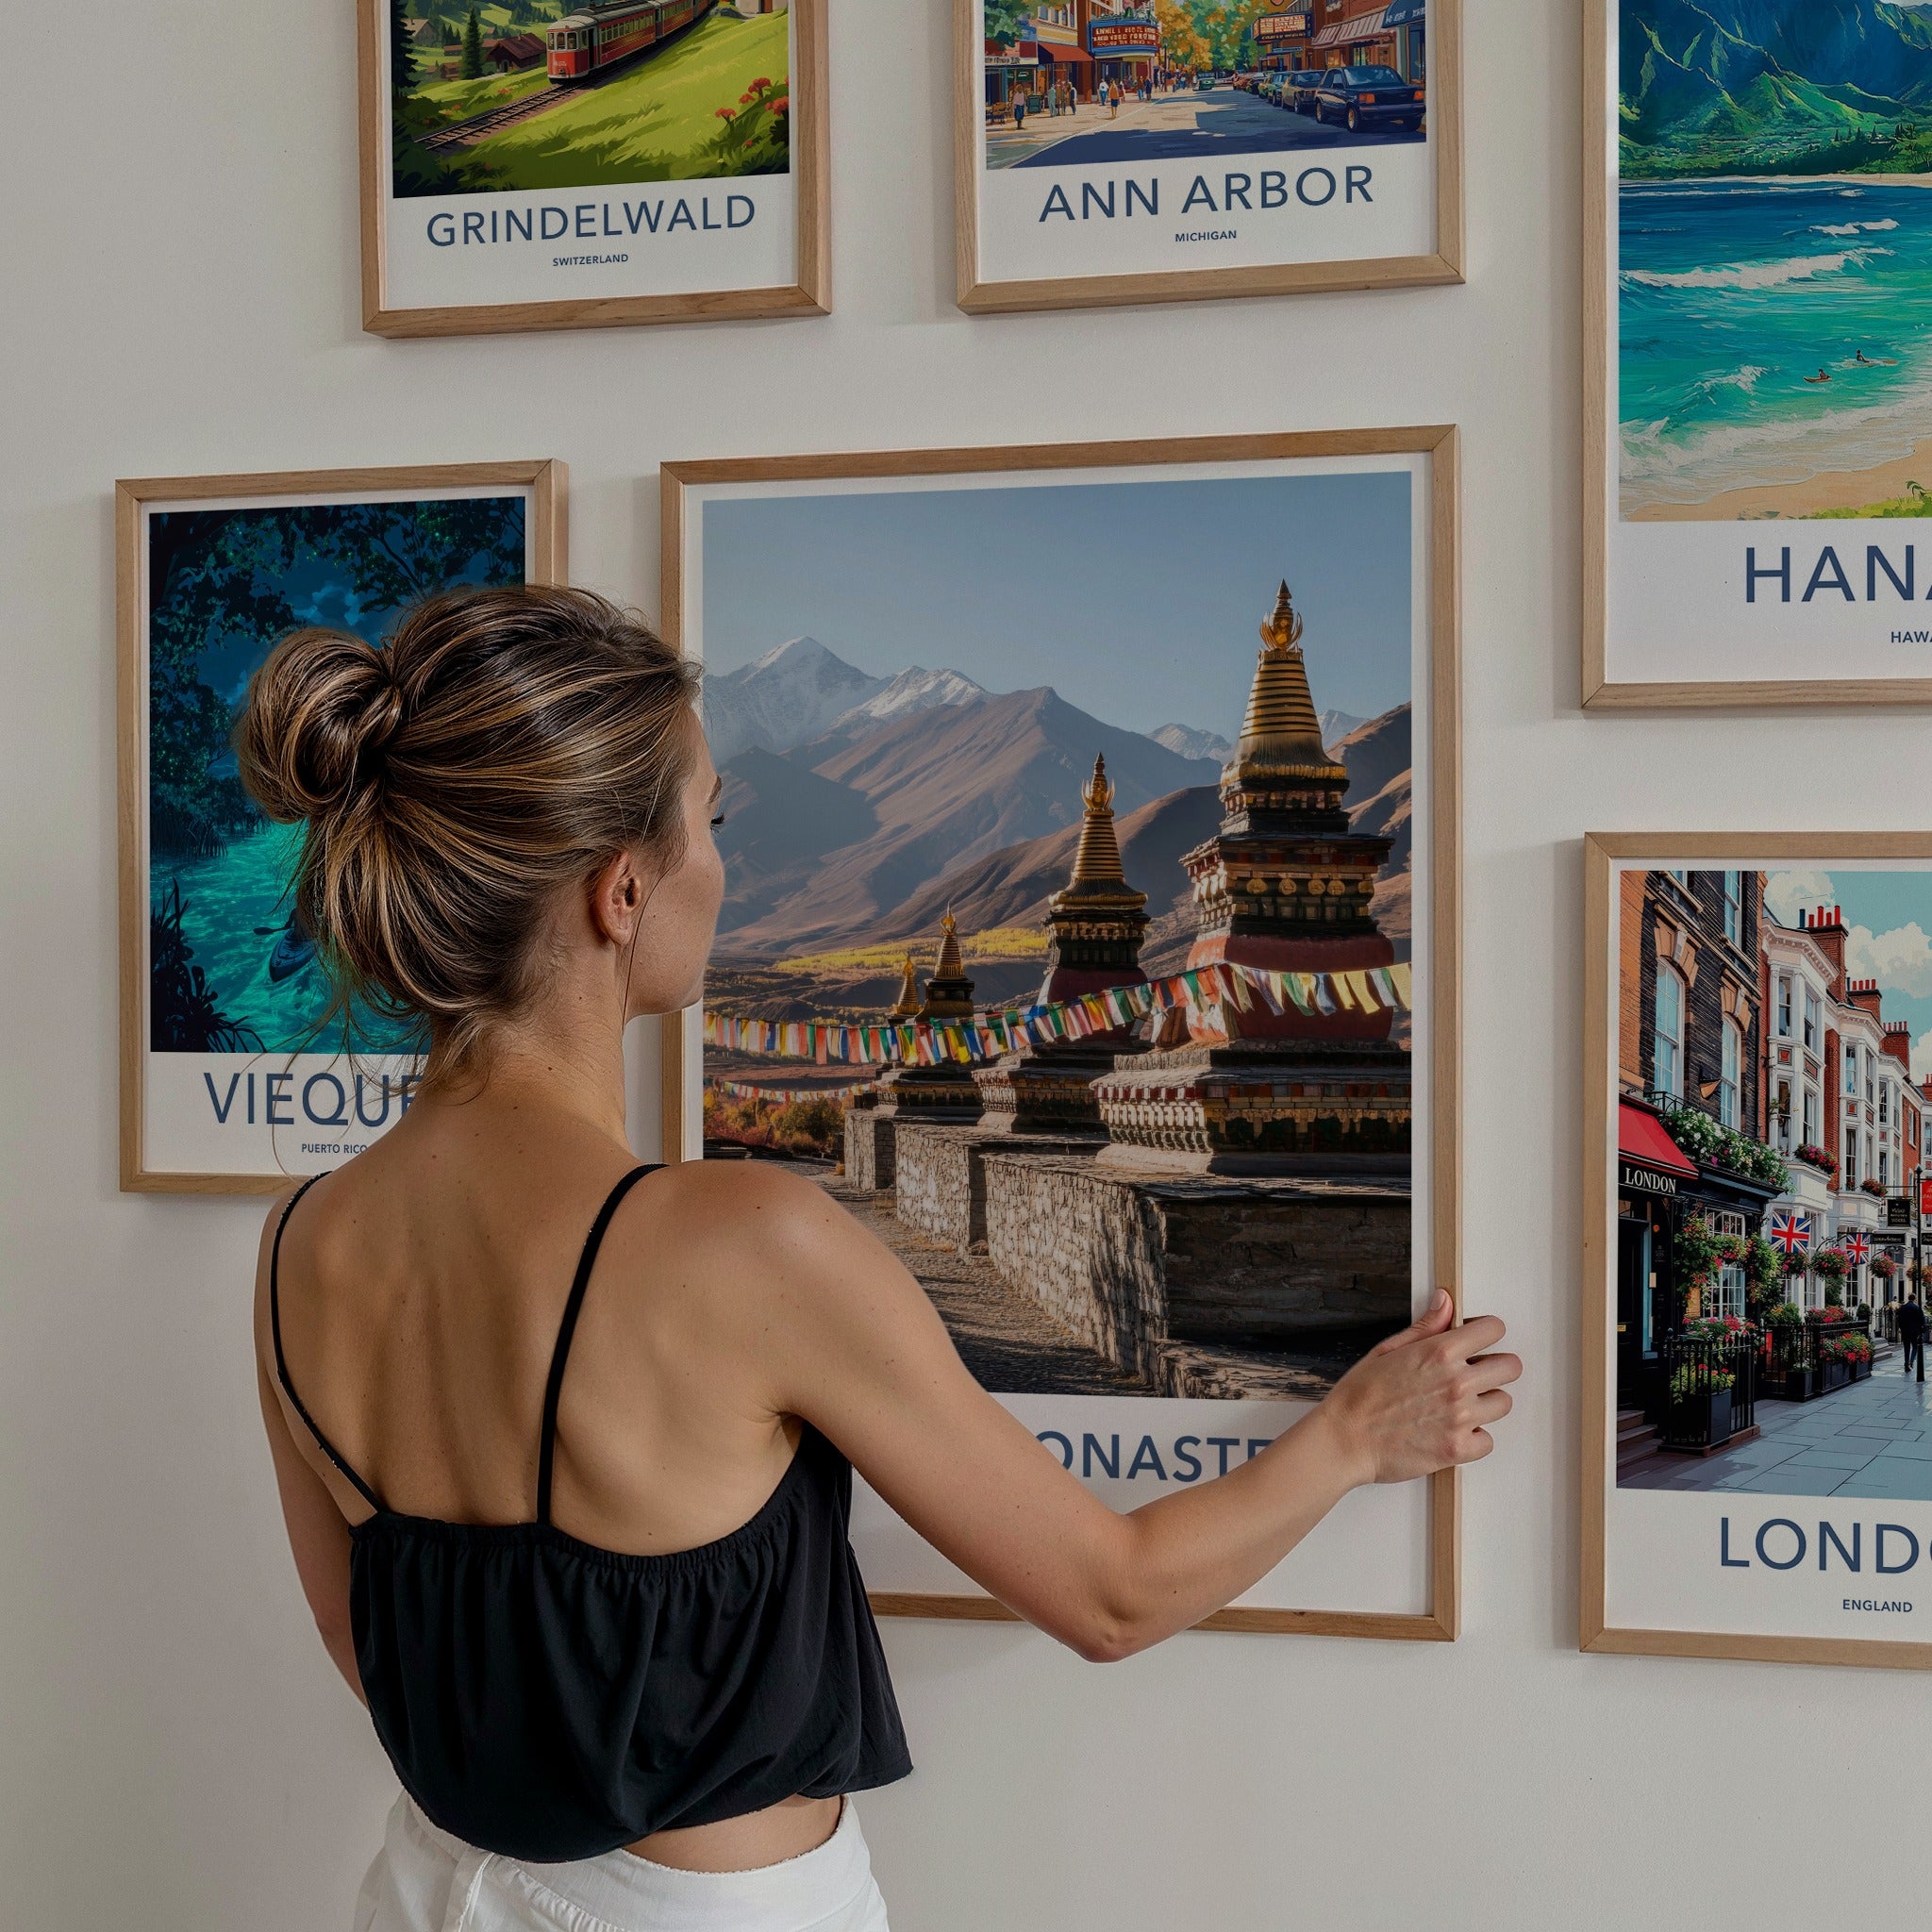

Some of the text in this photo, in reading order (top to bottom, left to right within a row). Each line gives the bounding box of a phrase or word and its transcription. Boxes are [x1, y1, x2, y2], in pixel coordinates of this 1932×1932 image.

[1039, 165, 1374, 223] ANN ARBOR
[426, 194, 756, 247] GRINDELWALD
[1174, 229, 1237, 242] MICHIGAN
[552, 253, 629, 267] SWITZERLAND
[1745, 544, 1932, 603] HAN
[1890, 630, 1932, 643] HAW
[301, 1142, 368, 1154] PUERTO RICO
[1624, 1167, 1676, 1194] LONDON
[1721, 1517, 1932, 1574] LOND
[1842, 1599, 1913, 1613] ENGLAND
